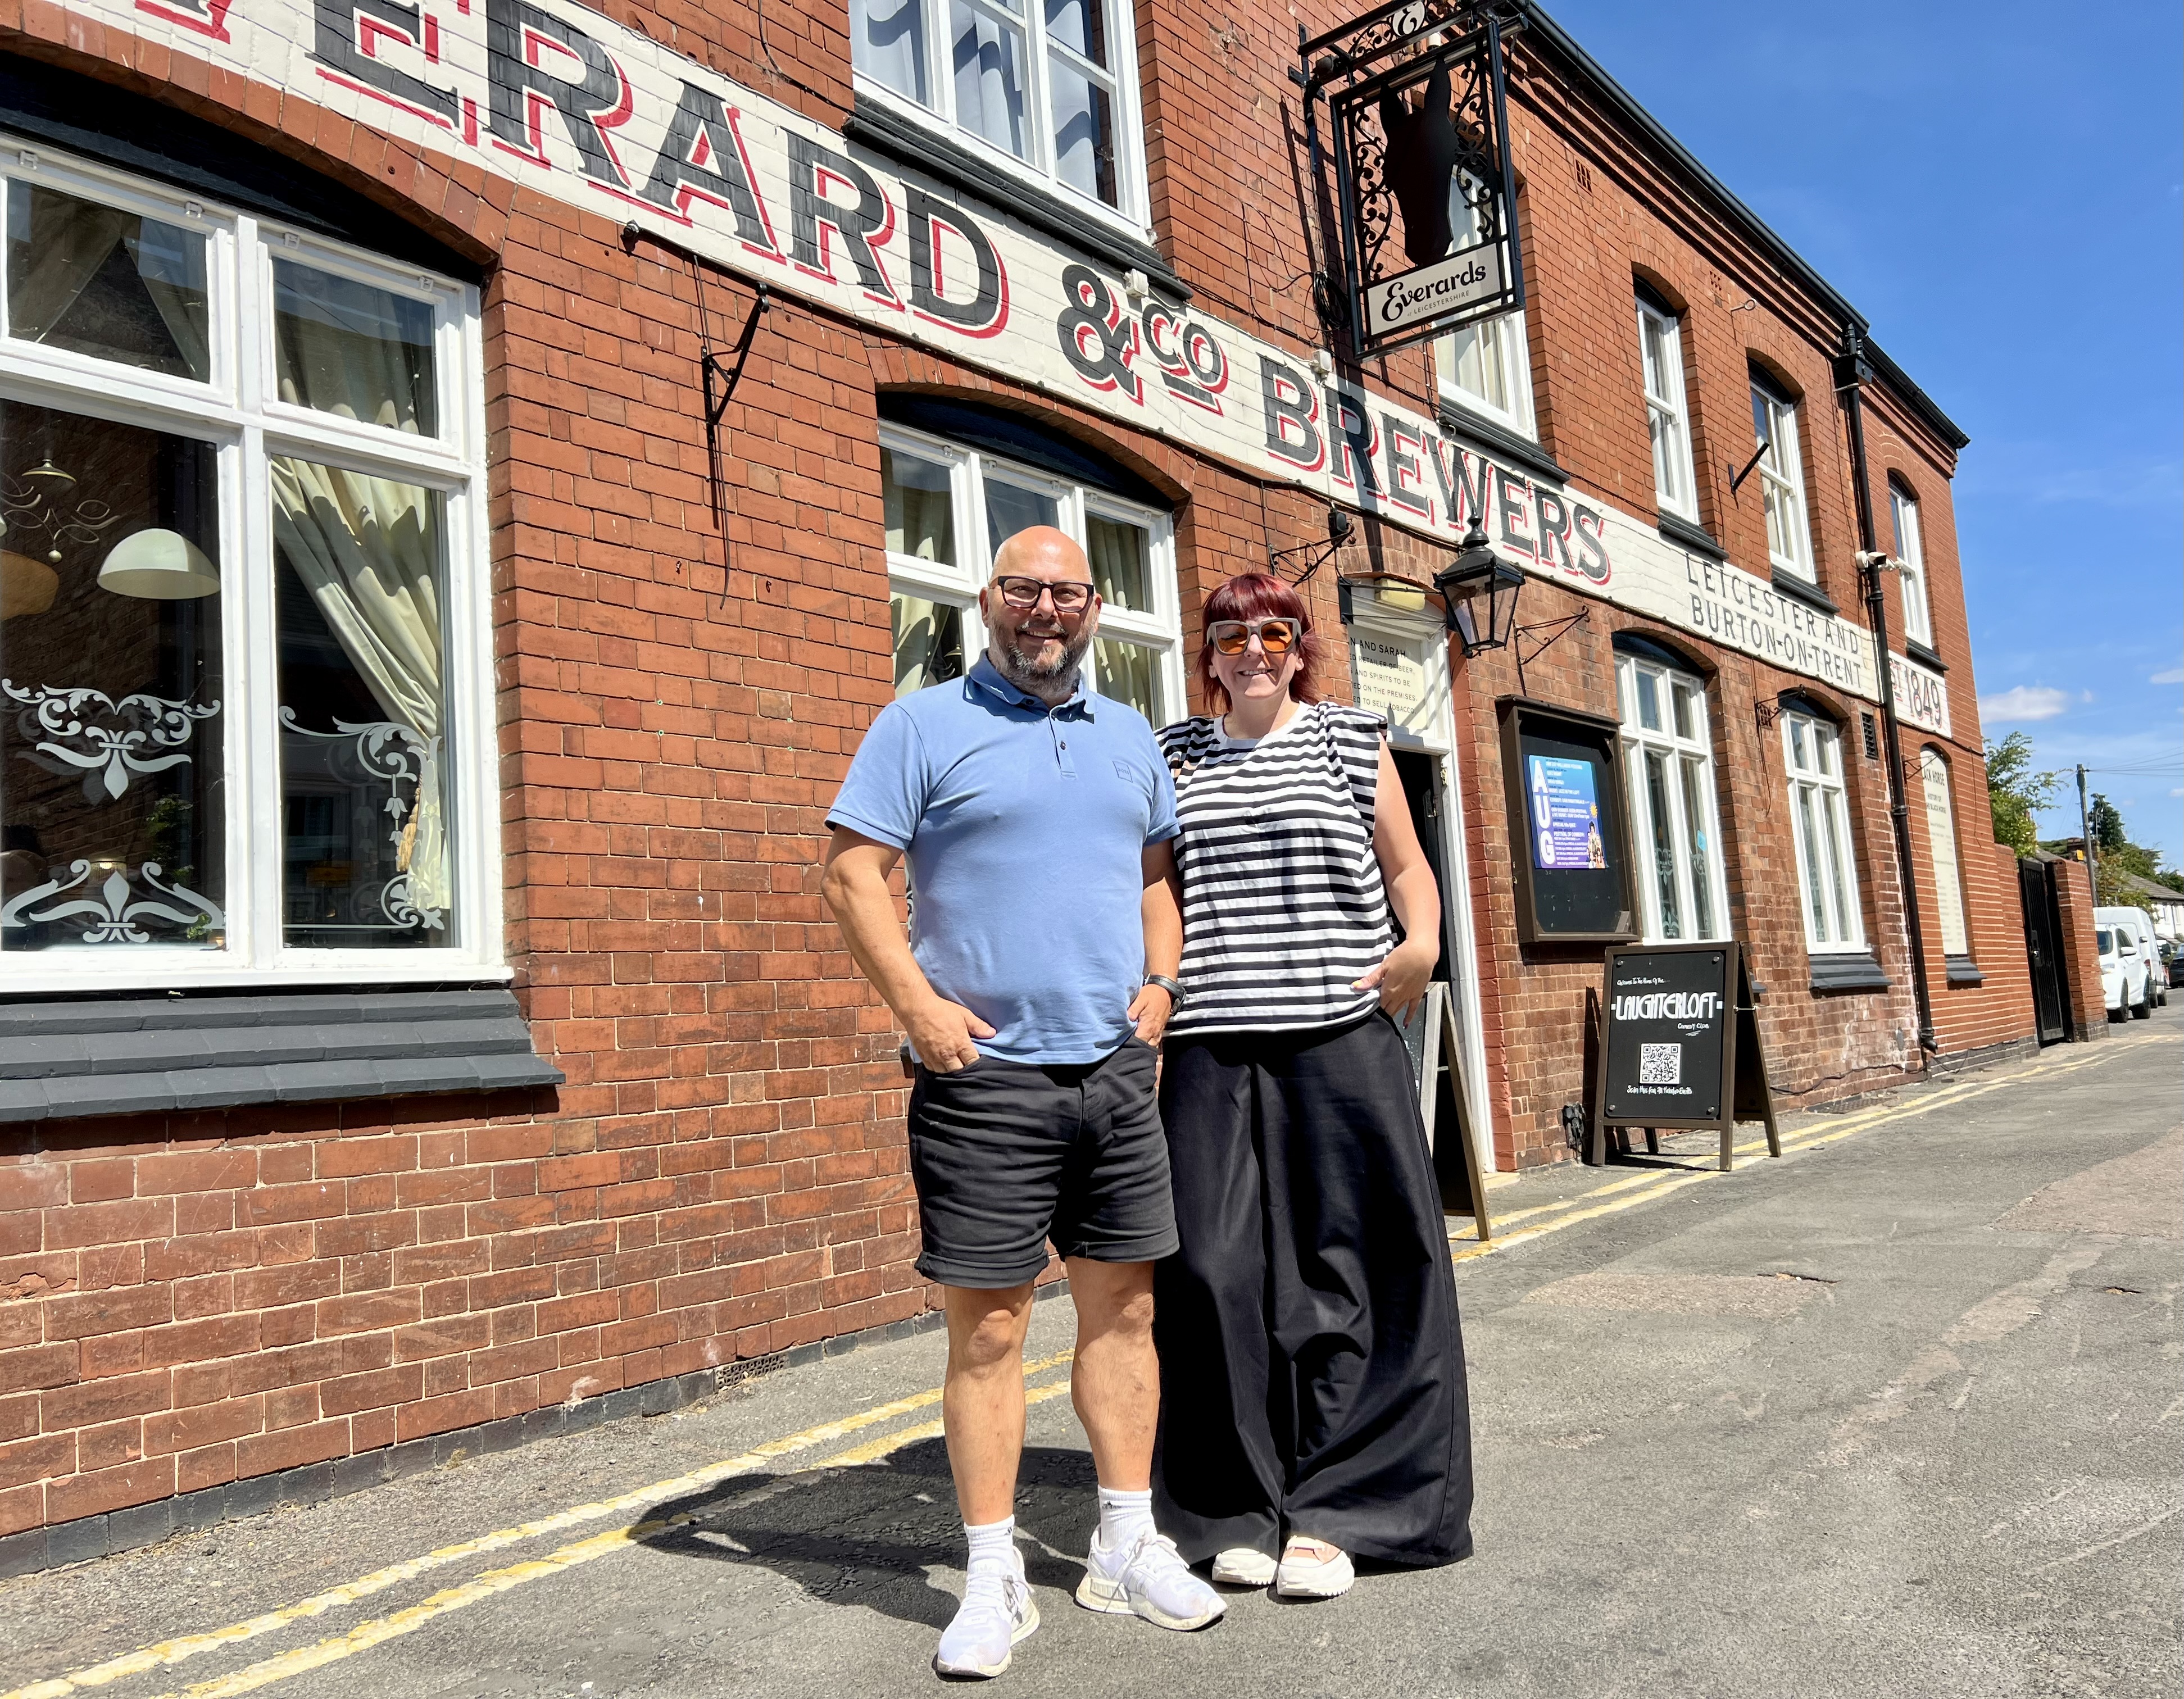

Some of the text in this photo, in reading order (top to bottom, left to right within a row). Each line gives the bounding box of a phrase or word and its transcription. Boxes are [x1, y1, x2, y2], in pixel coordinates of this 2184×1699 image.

[135, 0, 1010, 339] ERARD
[1056, 264, 1143, 406] &
[1256, 352, 1612, 585] BREWERS
[1381, 261, 1486, 322] Everards
[1414, 290, 1470, 315] LEICESTERSHIRE
[1686, 552, 1859, 655] LEICESTER AND
[1359, 639, 1376, 651] AND
[1379, 644, 1406, 658] SARAH
[1359, 655, 1387, 668] RETAILER
[1688, 593, 1861, 688] BURTON-ON-TRENT
[1369, 672, 1392, 683] SPIRITS
[1373, 700, 1387, 708] SELL
[1904, 665, 1942, 728] 1849
[1533, 760, 1555, 865] AUG
